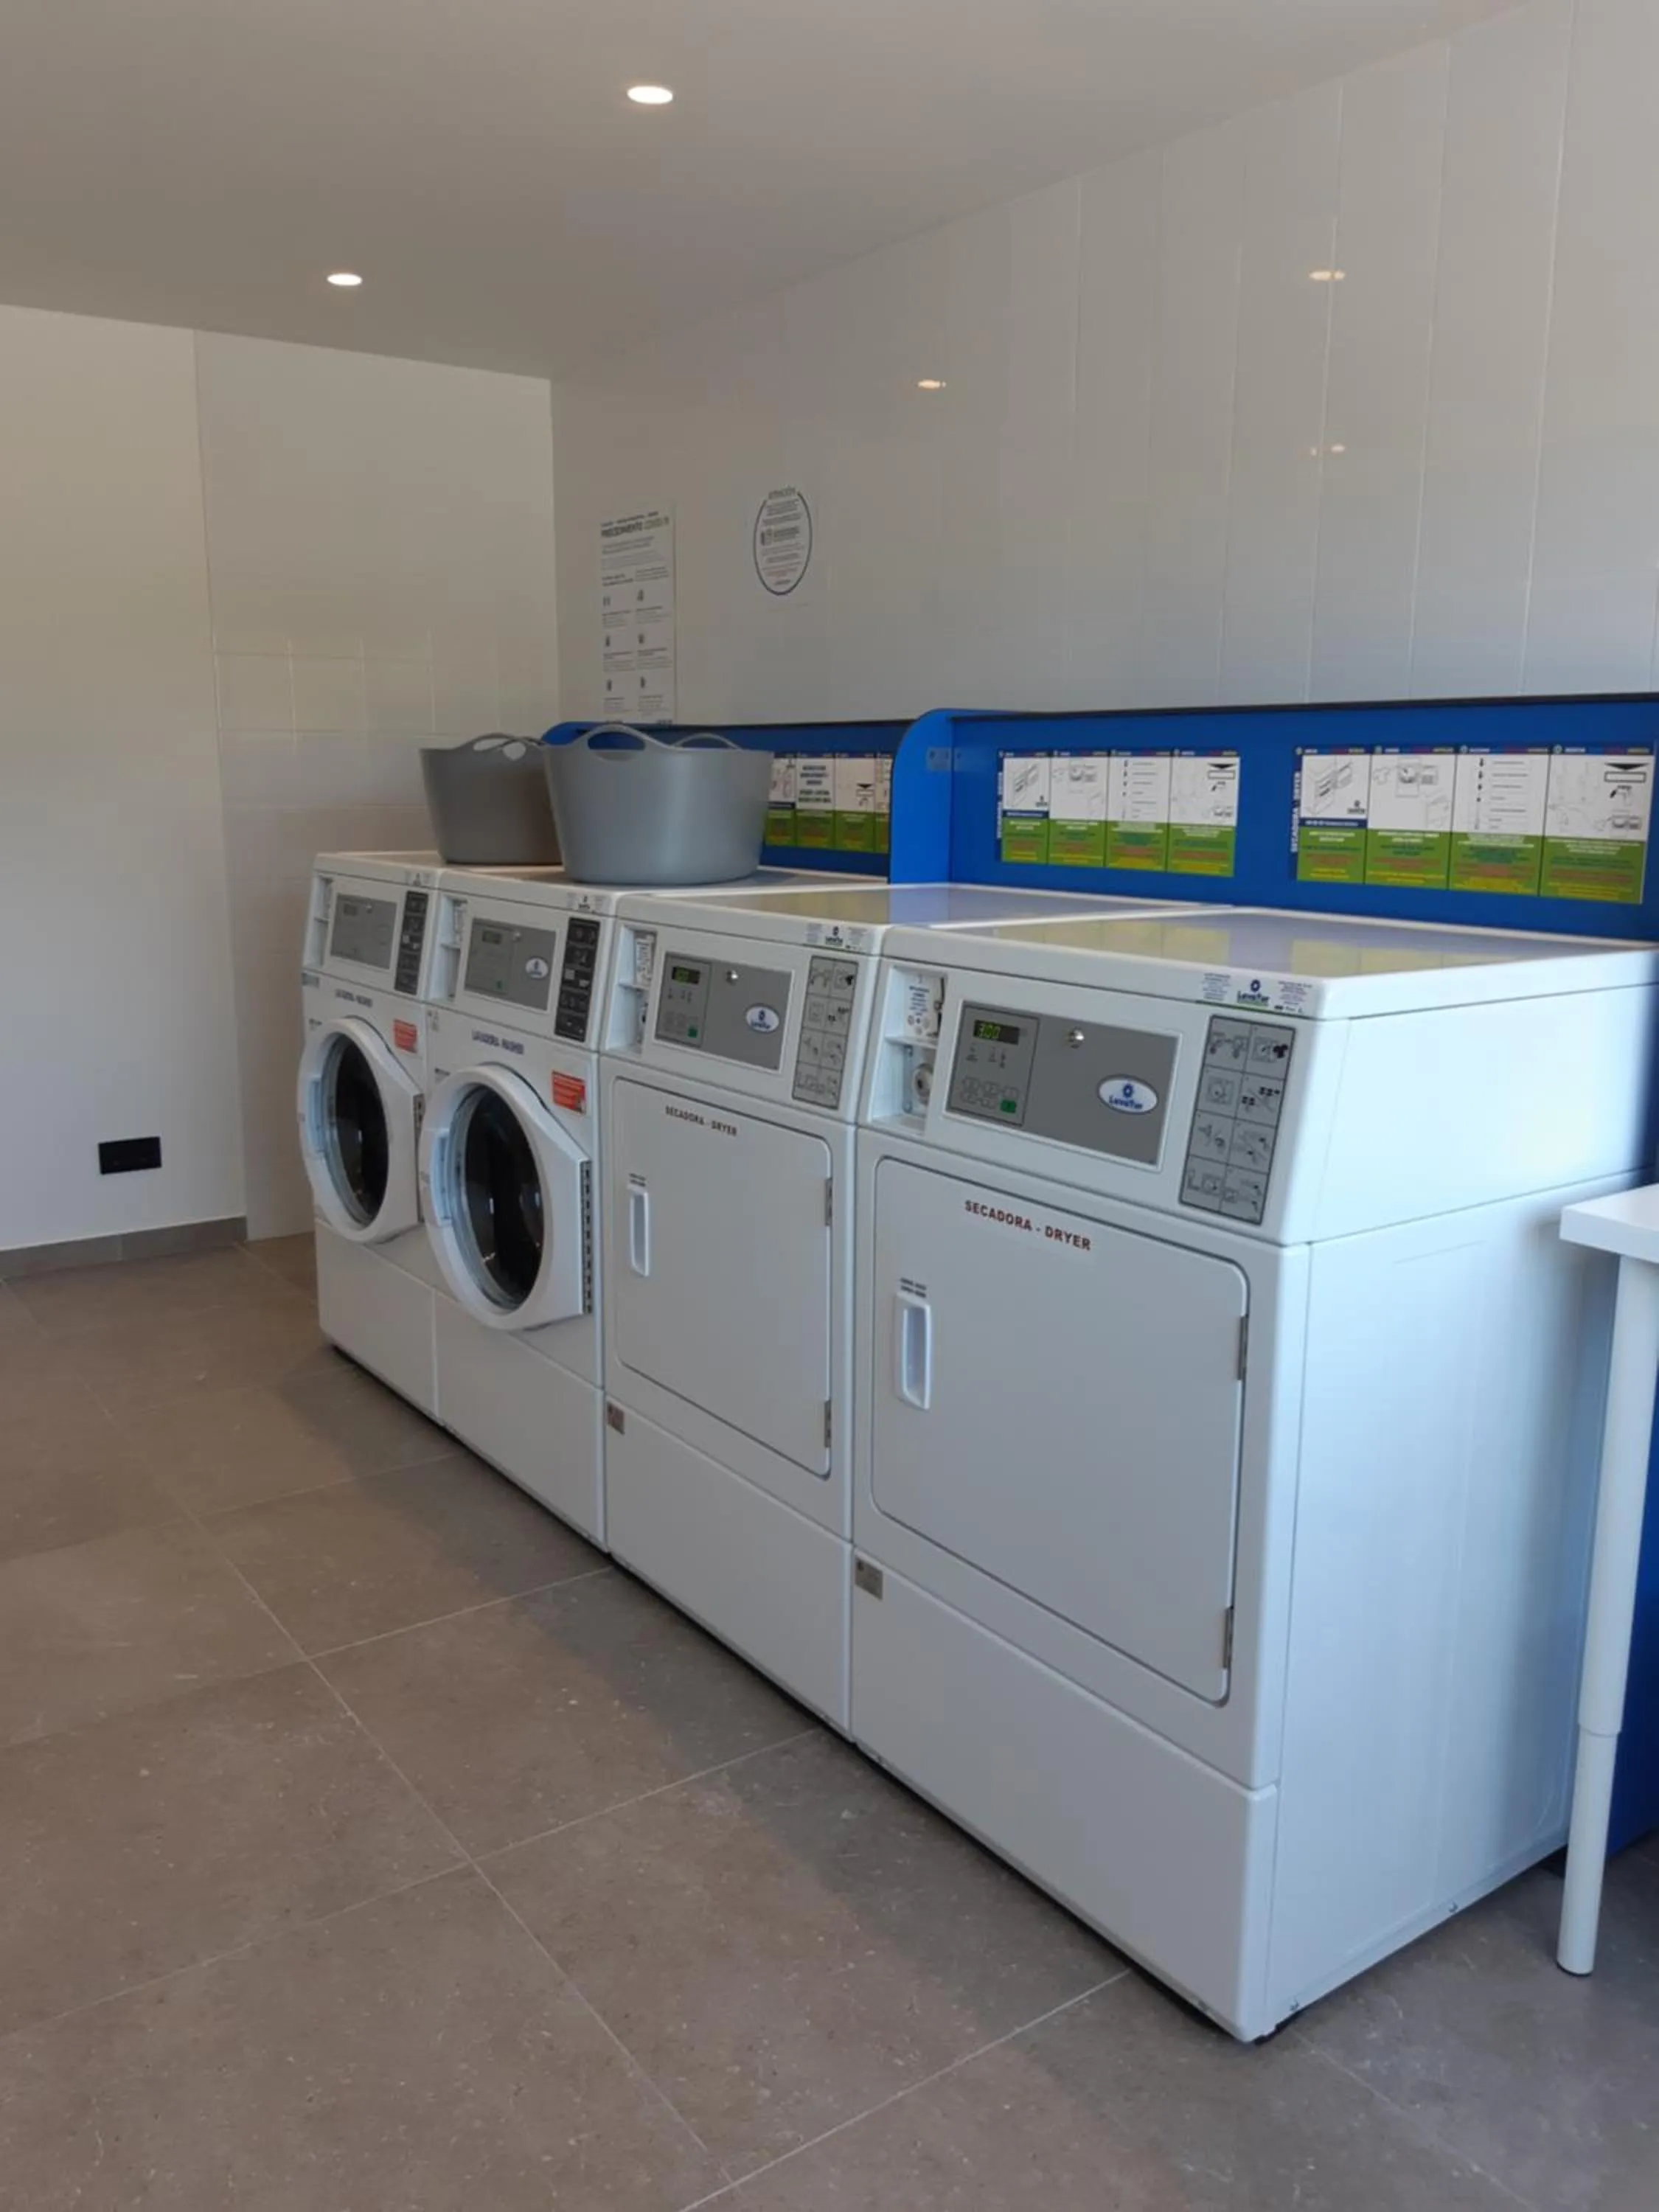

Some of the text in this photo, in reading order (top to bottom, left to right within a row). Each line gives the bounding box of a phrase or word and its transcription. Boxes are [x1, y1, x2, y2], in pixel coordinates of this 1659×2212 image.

[665, 1105, 705, 1126] SECADORA
[712, 1120, 737, 1136] DRYER
[965, 1200, 1032, 1231] SECADORA
[1045, 1225, 1092, 1251] DRYER
